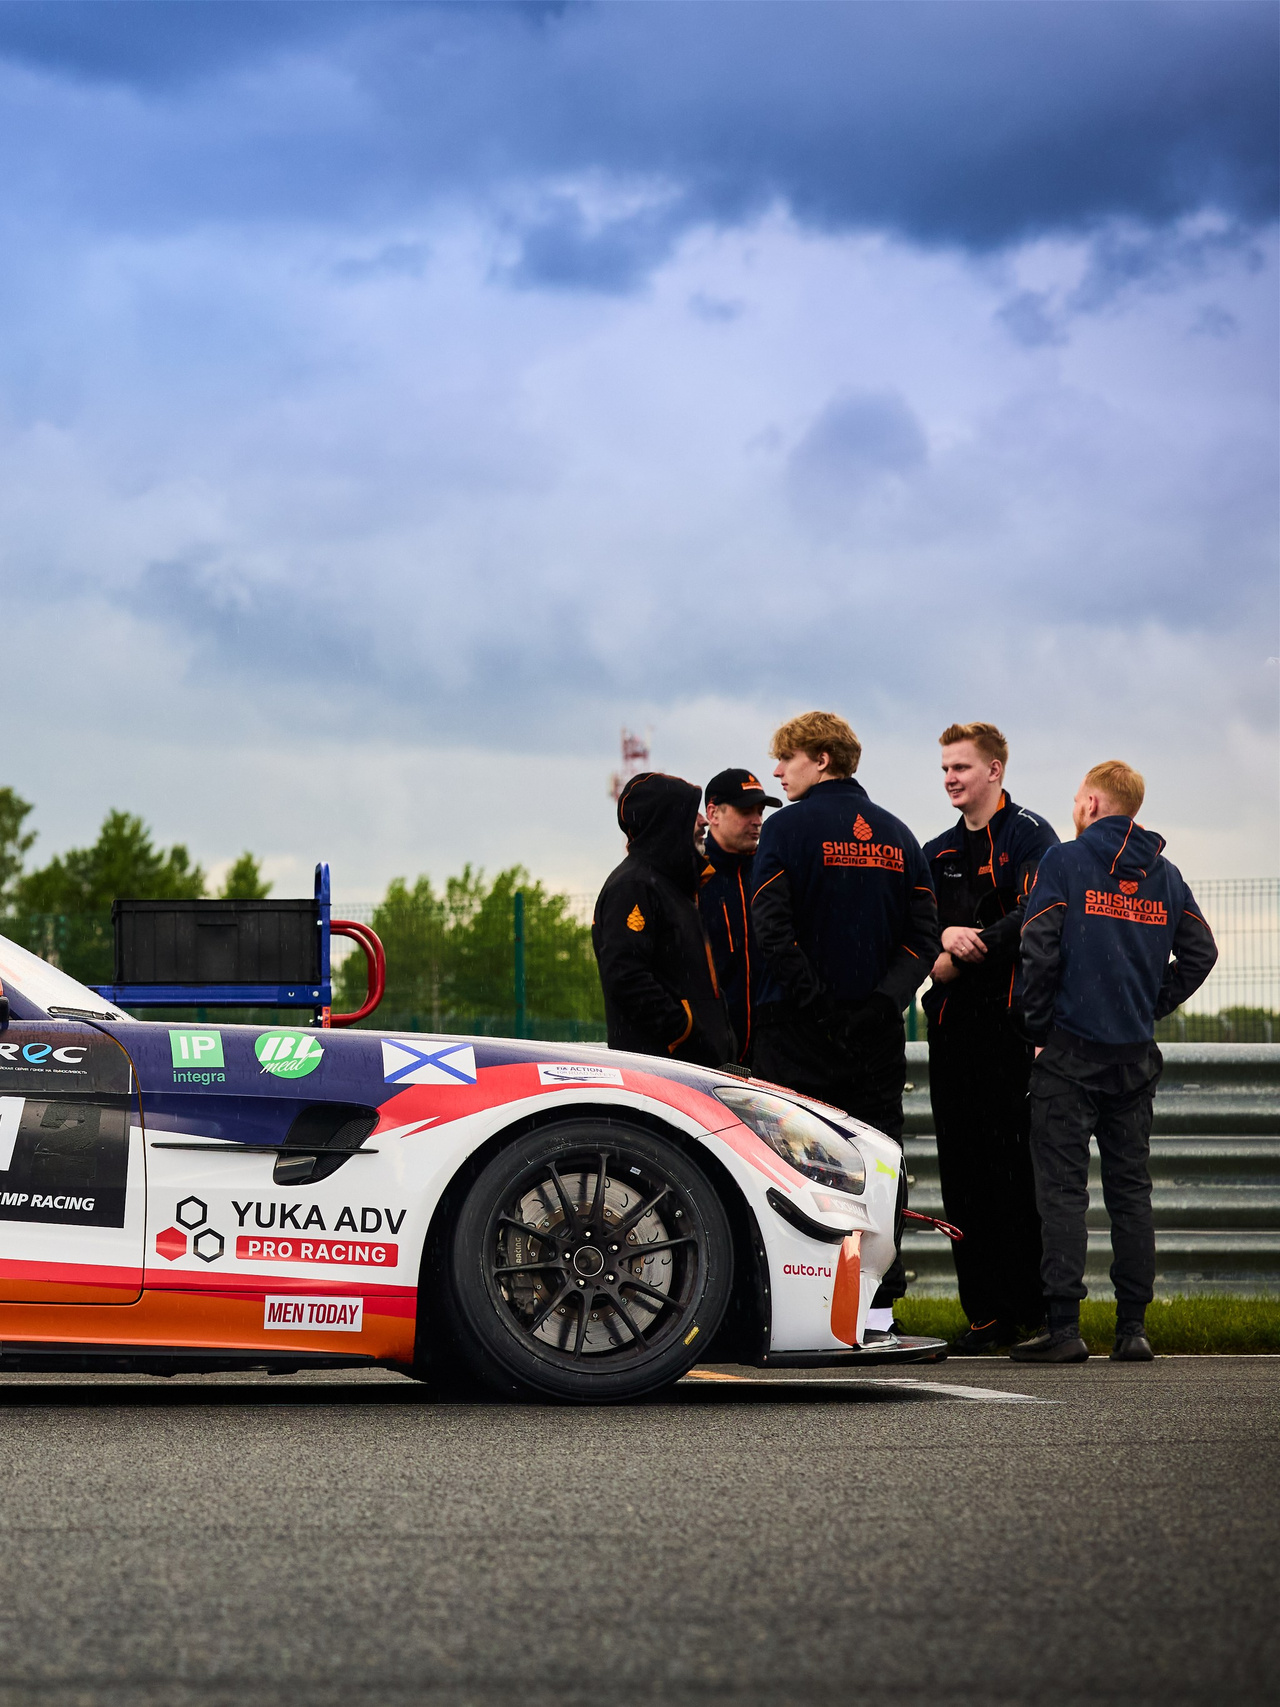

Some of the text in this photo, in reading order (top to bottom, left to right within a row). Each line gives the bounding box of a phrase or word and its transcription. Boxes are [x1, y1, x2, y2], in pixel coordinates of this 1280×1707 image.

[822, 841, 904, 862] SHISHKOIL
[826, 857, 904, 870] RACING TEAM
[1085, 890, 1167, 914] SHISHKOIL
[1088, 906, 1165, 923] RACING TEAM
[179, 1036, 216, 1060] IP
[260, 1054, 312, 1075] meal
[173, 1070, 226, 1085] integra
[31, 1194, 95, 1211] RACING
[231, 1200, 407, 1235] YUKA ADV
[248, 1239, 386, 1264] PRO RACING
[783, 1264, 831, 1278] auto.ru
[268, 1300, 360, 1326] MEN TODAY
